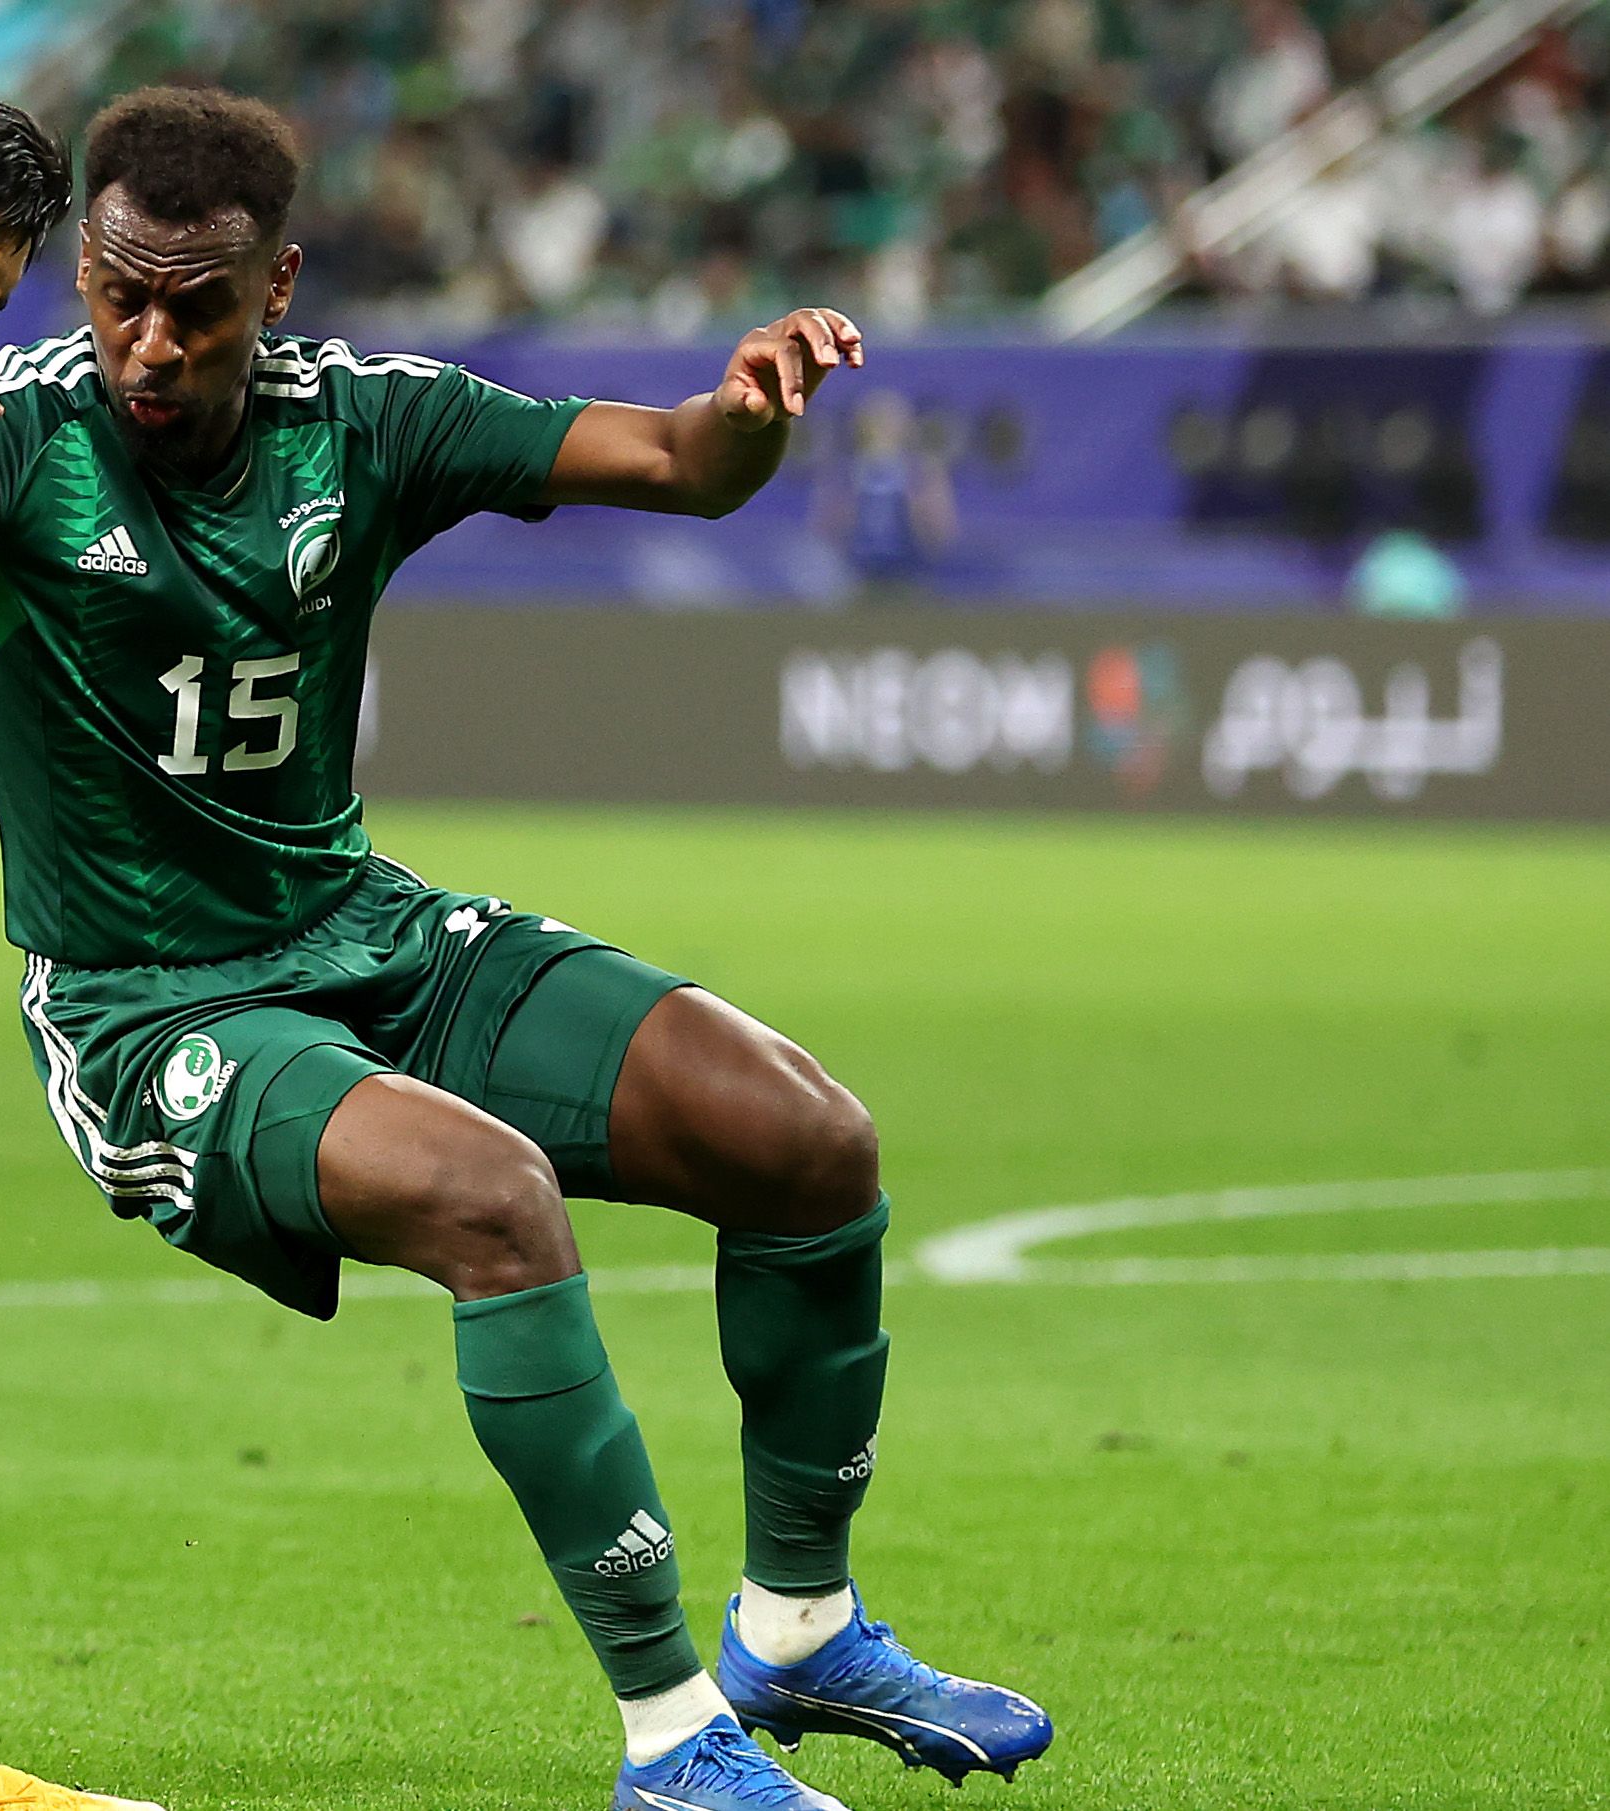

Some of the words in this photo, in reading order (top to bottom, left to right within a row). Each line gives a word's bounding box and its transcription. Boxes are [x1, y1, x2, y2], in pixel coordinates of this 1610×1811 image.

[77, 551, 148, 575] adidas
[157, 651, 301, 776] 15
[780, 648, 1072, 772] NEOM
